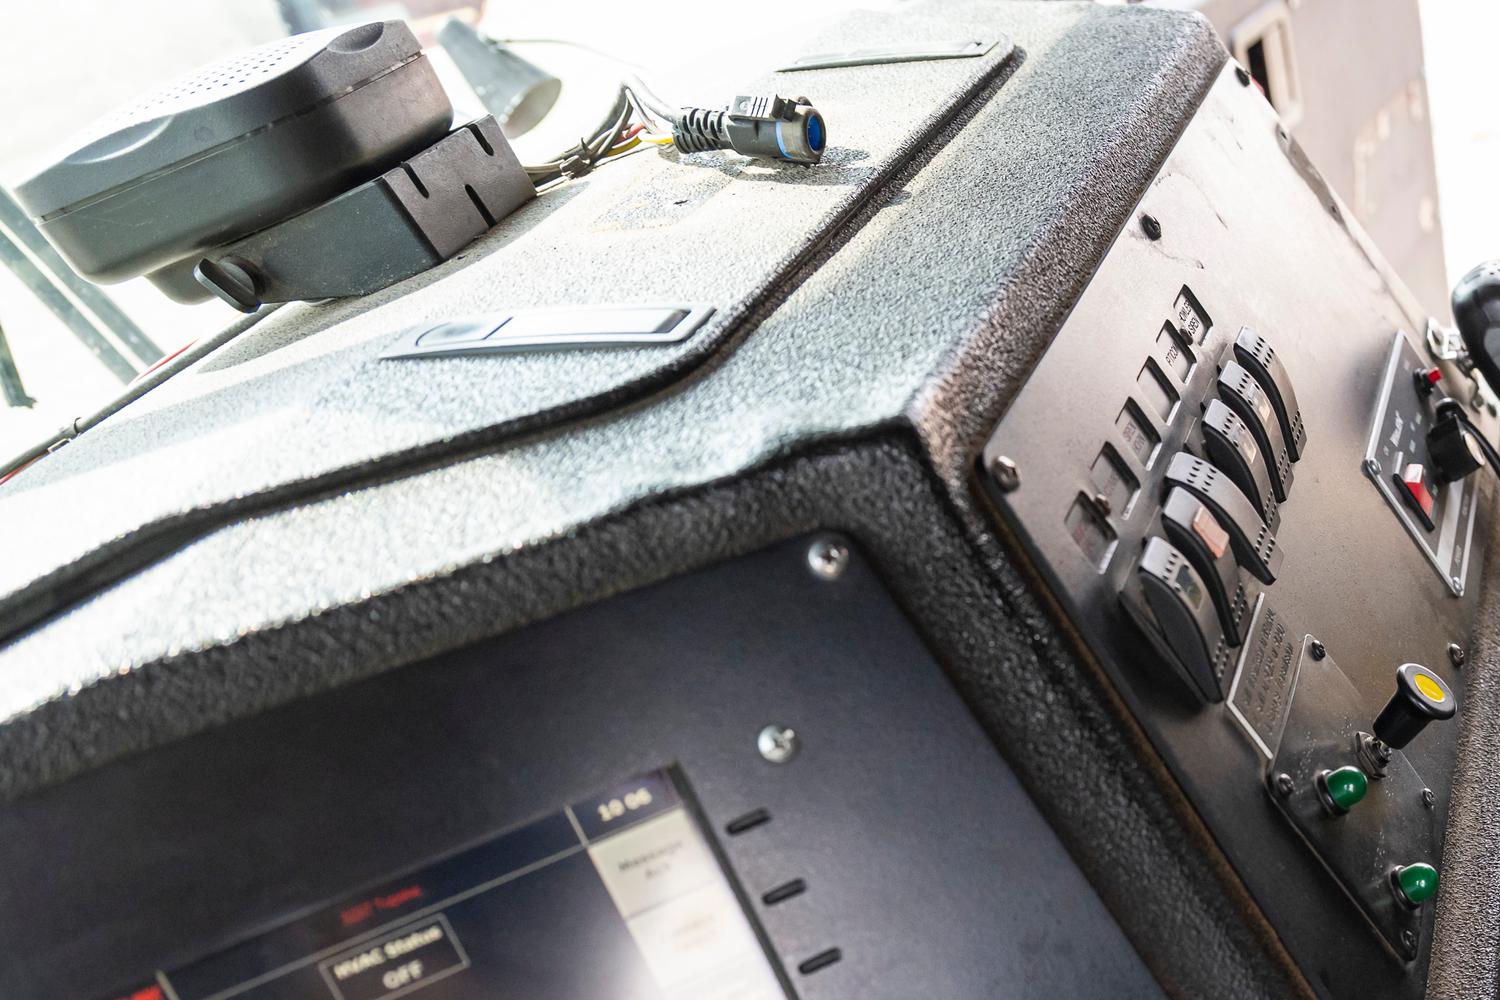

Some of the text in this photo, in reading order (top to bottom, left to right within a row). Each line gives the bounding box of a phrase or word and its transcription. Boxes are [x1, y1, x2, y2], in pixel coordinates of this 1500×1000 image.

[335, 925, 442, 979] HVAC Status
[383, 961, 424, 990] OFF
